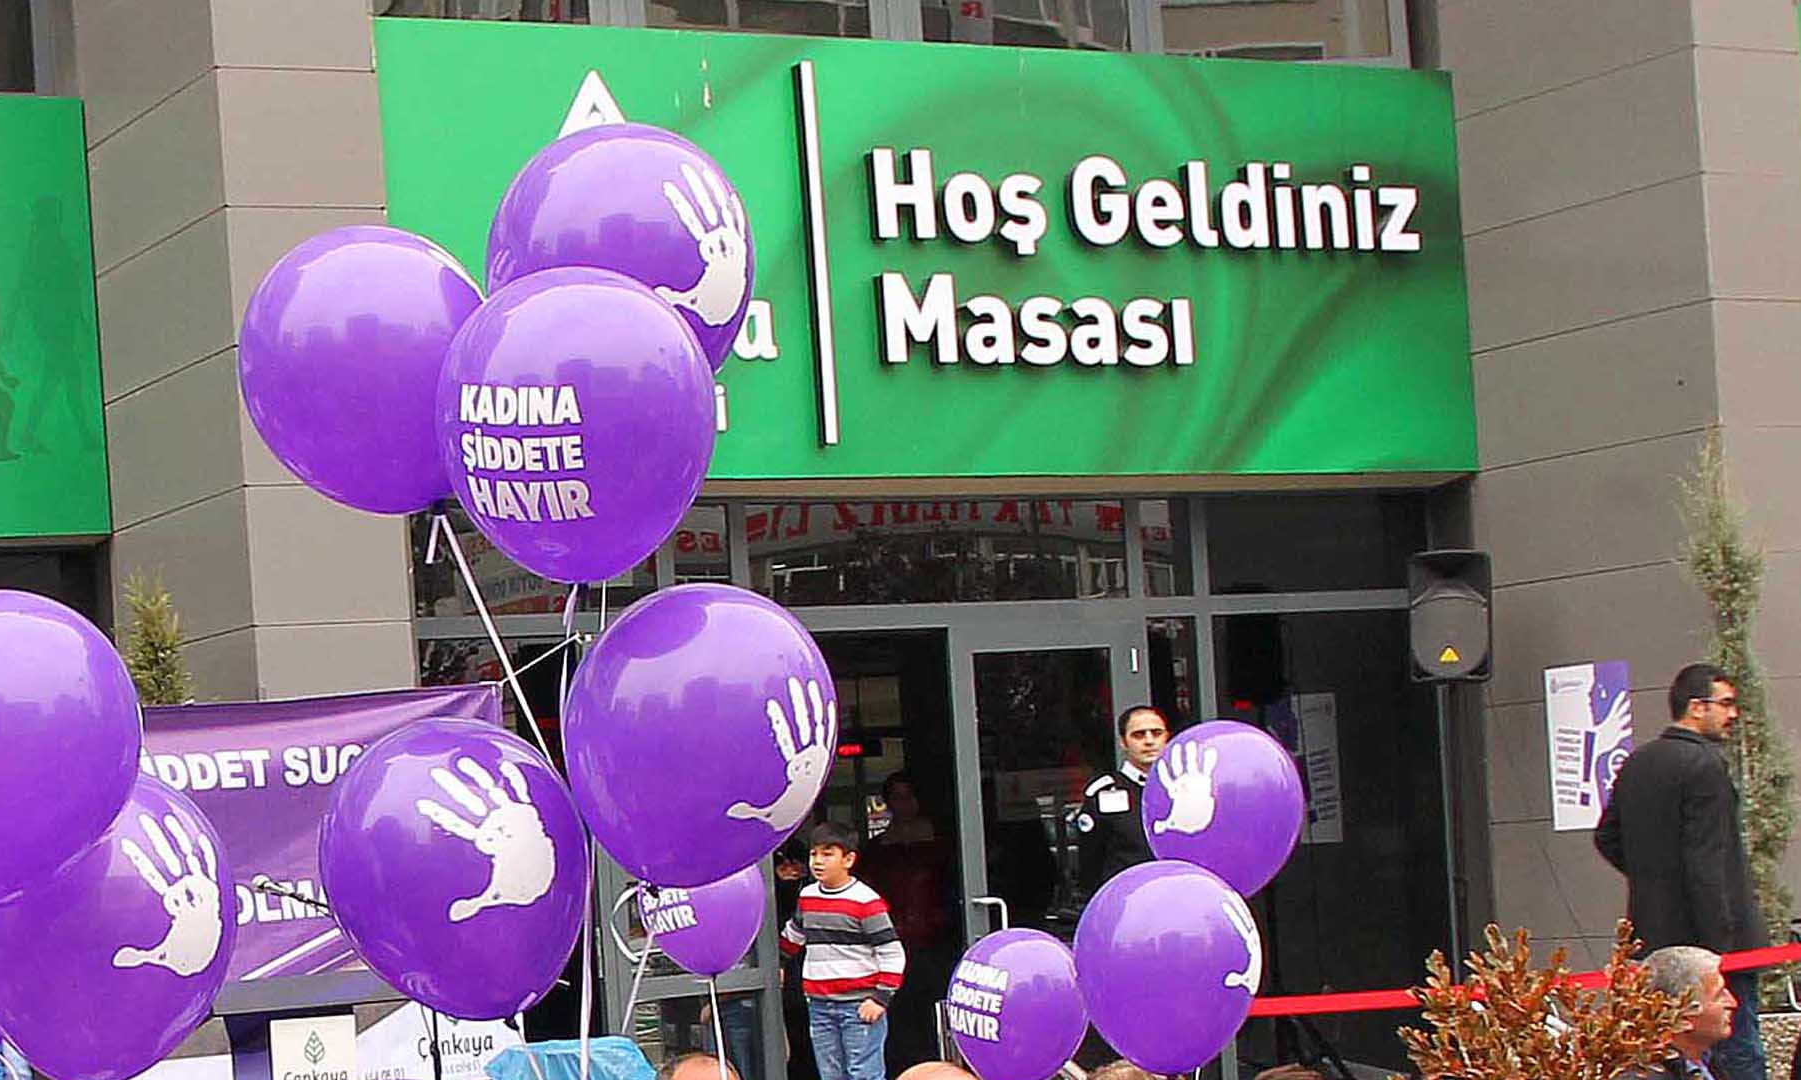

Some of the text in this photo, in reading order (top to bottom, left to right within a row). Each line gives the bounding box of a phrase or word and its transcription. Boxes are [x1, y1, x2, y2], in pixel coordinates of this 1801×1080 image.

[871, 147, 1421, 255] Hoş Geldiniz
[881, 272, 1195, 366] Masası
[460, 383, 582, 426] KADINA
[461, 427, 584, 473] ŞİDDETE
[467, 474, 597, 522] HAYIR
[950, 1004, 1000, 1042] HAYIR
